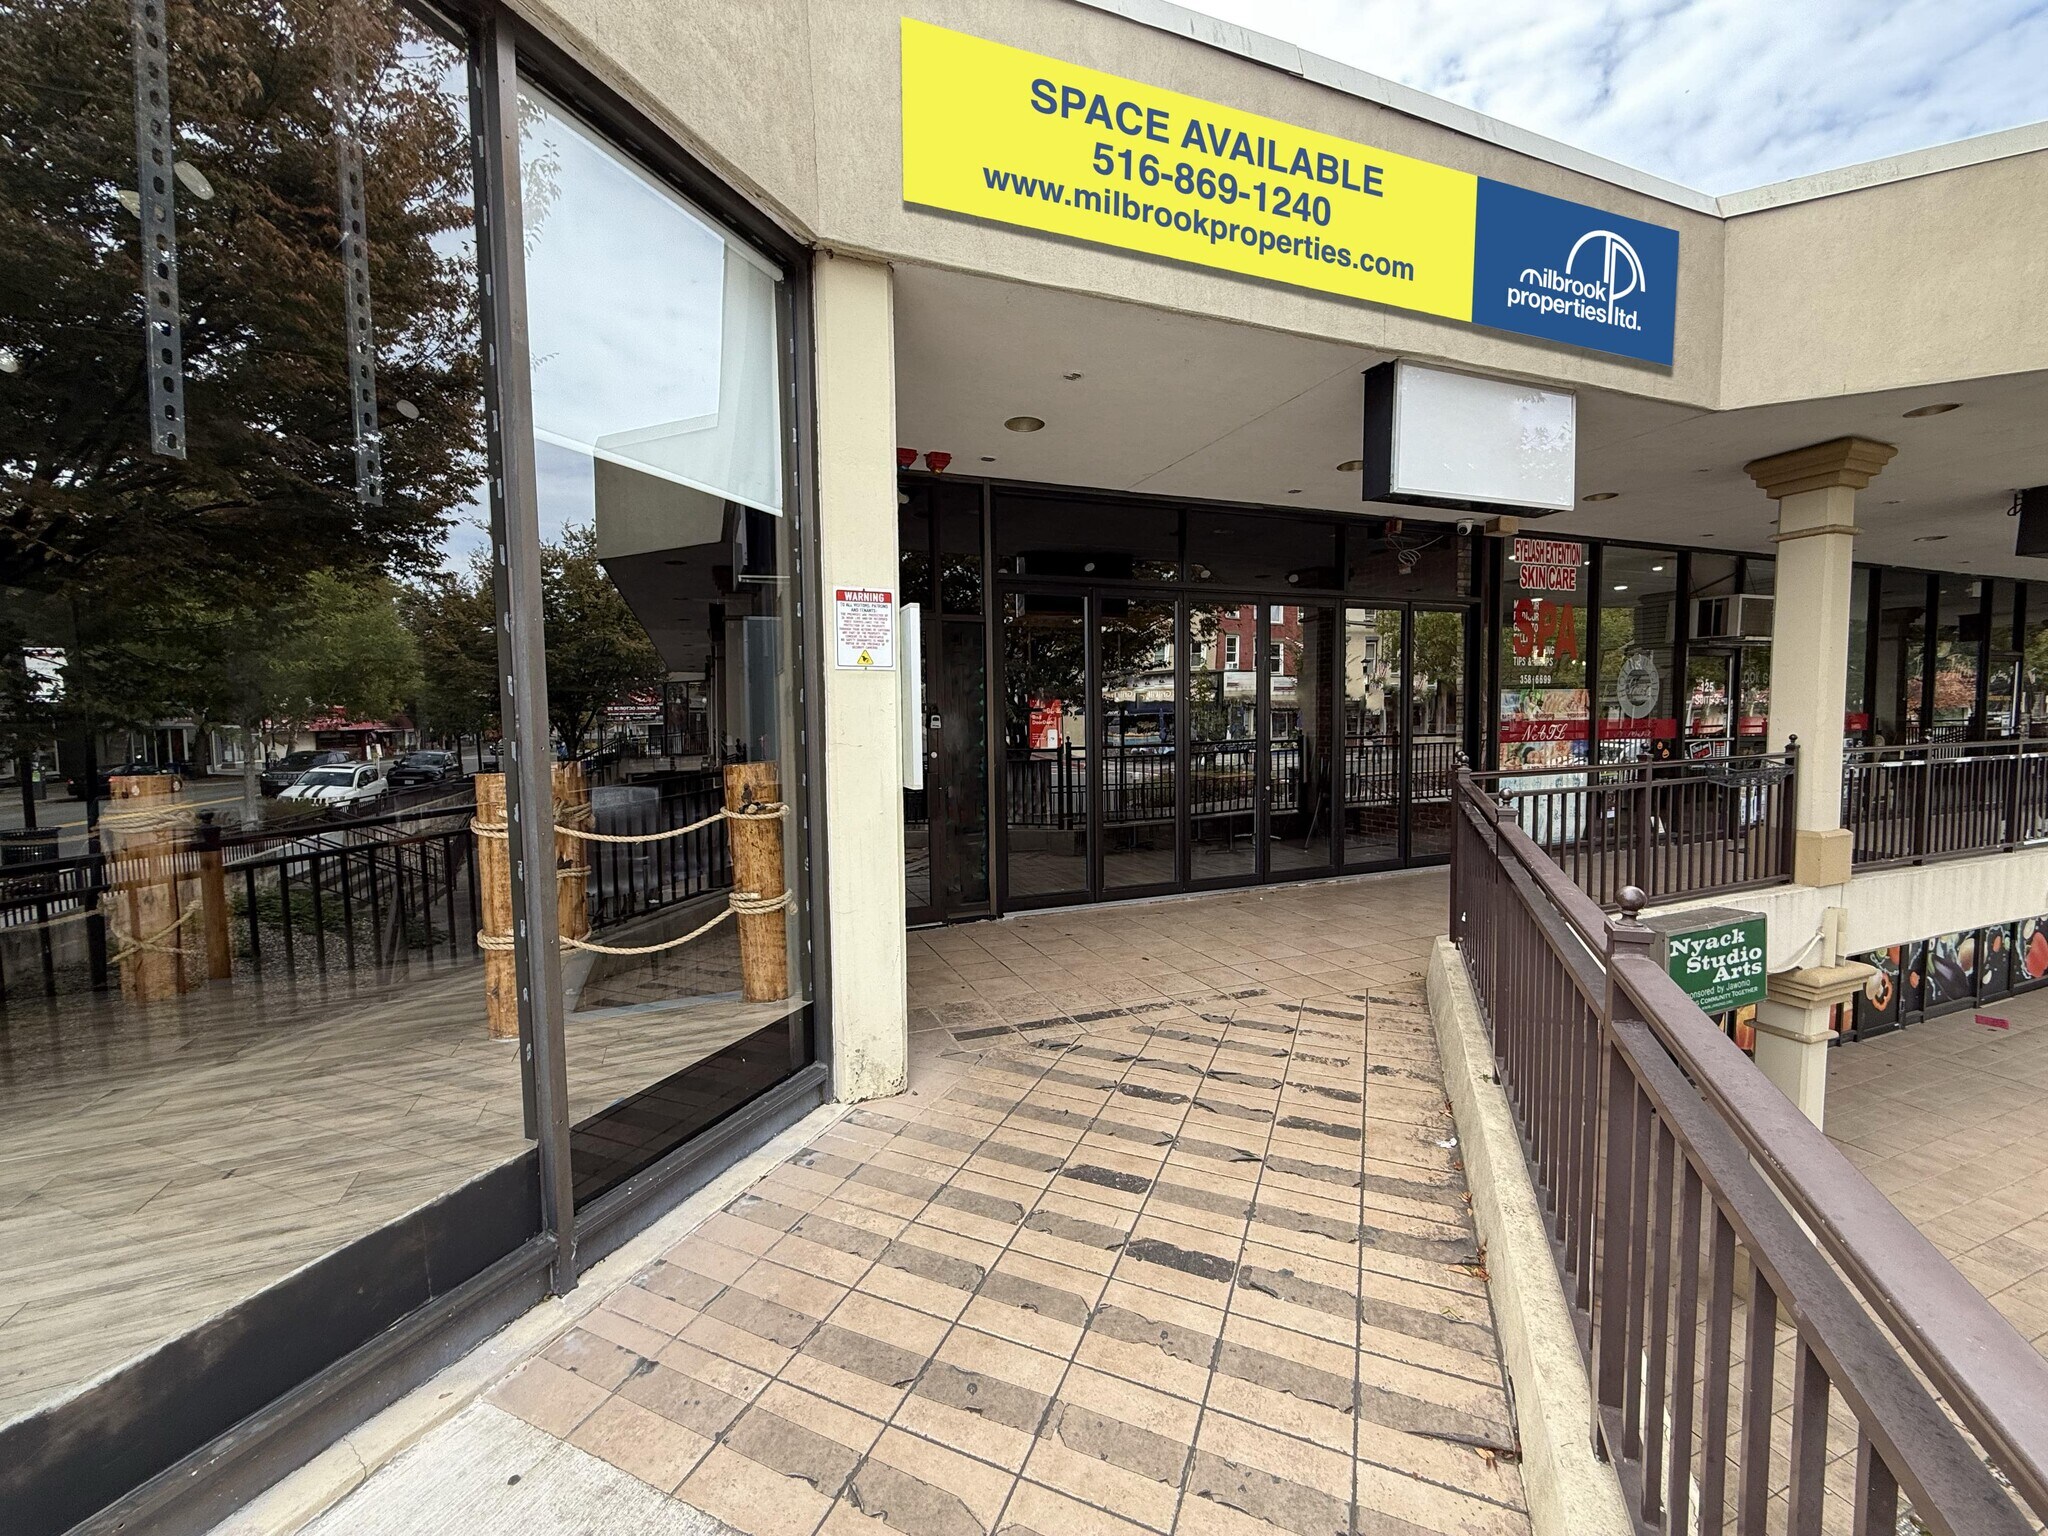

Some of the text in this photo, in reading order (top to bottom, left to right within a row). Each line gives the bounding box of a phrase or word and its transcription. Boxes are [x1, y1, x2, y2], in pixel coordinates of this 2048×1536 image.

[1031, 79, 1384, 198] SPACE AVAILABLE
[1093, 142, 1331, 227] 516-869-1240
[983, 167, 1414, 282] www.milbrookproperties.com
[1520, 268, 1607, 301] milbrook
[1507, 287, 1642, 331] properties ltd.
[1514, 538, 1581, 567] EYELASH EXTENTION
[1520, 564, 1576, 591] SKIN CARE
[844, 591, 885, 603] WARNING
[1512, 597, 1579, 660] SPA
[1669, 928, 1745, 957] Nyack
[1686, 946, 1762, 974] Studio
[1712, 961, 1762, 984] Arts
[1716, 985, 1724, 993] by
[1726, 979, 1751, 991] Jawonio
